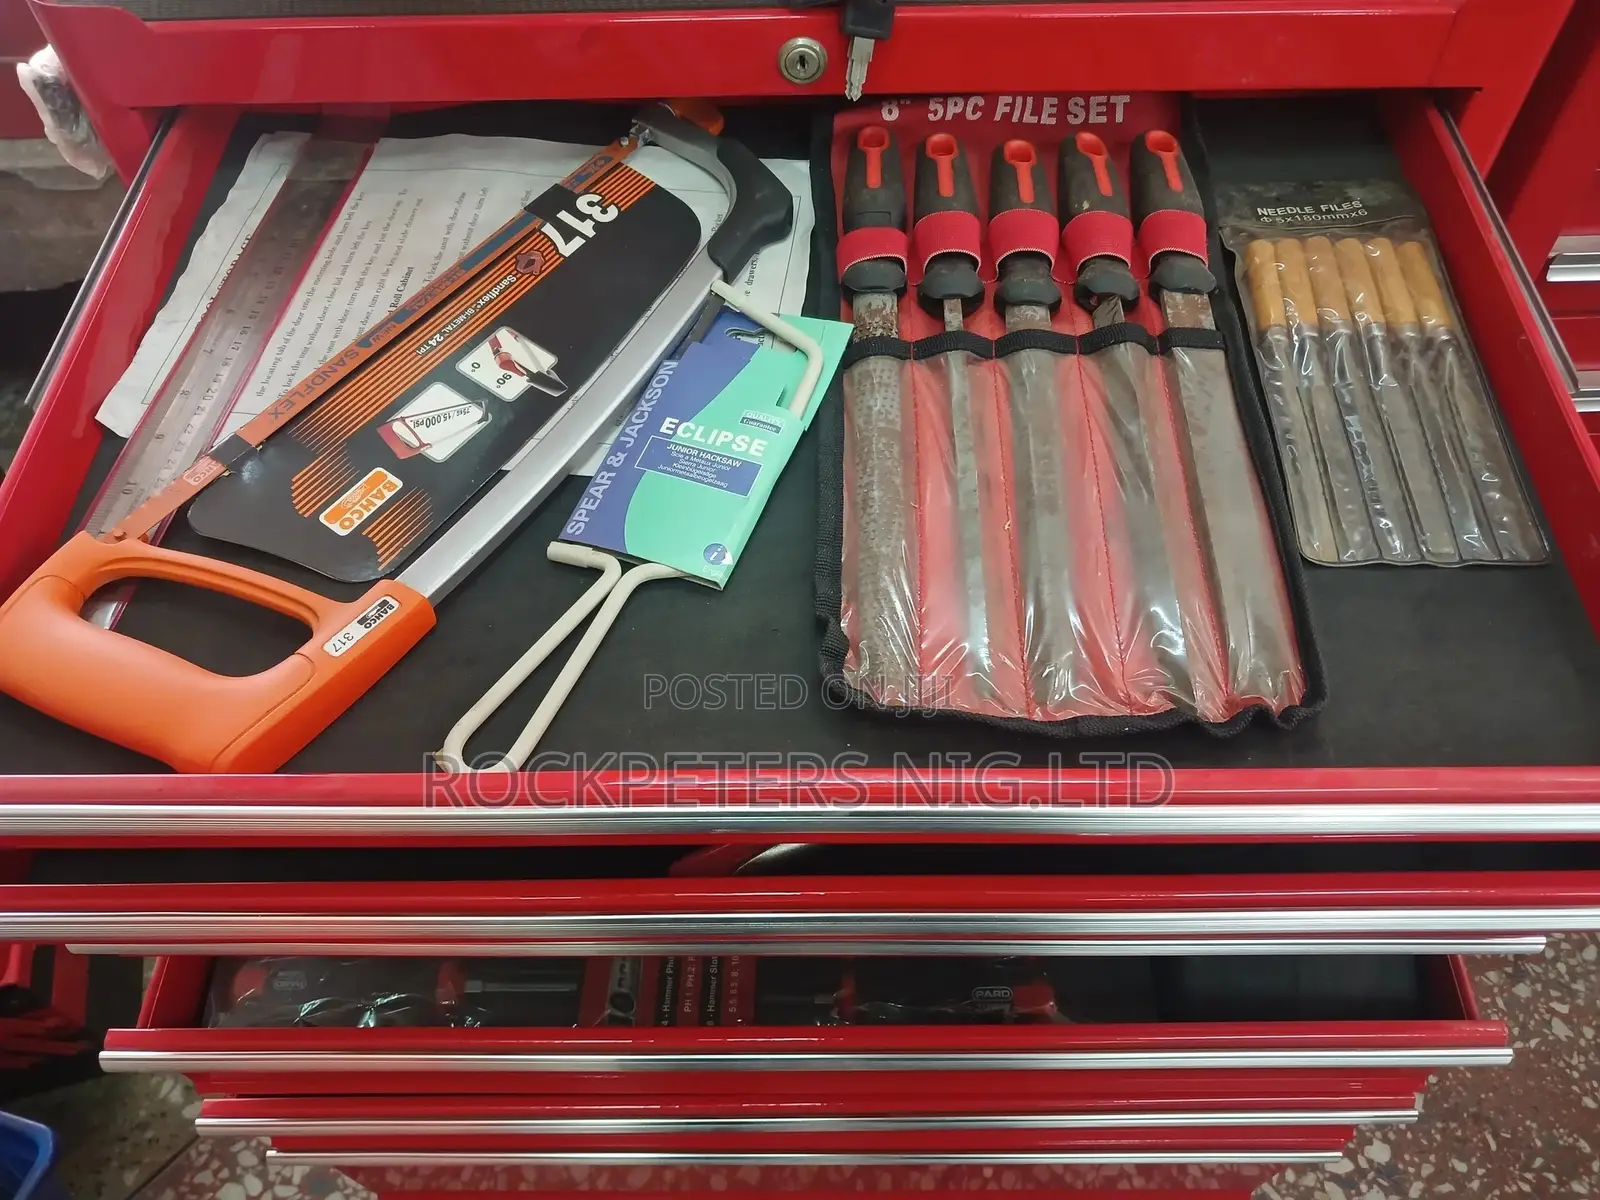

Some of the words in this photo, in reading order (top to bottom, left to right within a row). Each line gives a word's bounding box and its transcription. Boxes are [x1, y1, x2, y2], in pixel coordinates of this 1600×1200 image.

[927, 96, 983, 121] 5PC
[993, 95, 1058, 124] FILE
[1066, 94, 1131, 123] SET
[1257, 206, 1315, 216] NEEDLE
[1320, 200, 1363, 212] FILES
[541, 192, 619, 258] 317
[389, 292, 402, 308] Roll
[396, 264, 415, 293] Cabinet
[238, 323, 251, 337] 16
[439, 306, 475, 336] BI-METAL
[370, 321, 397, 343] NEW
[426, 331, 444, 348] 24
[228, 338, 242, 353] 17
[414, 342, 429, 356] TPI
[201, 385, 217, 403] 20
[267, 351, 357, 421] SANDFLEX
[192, 404, 206, 419] 21
[659, 417, 768, 457] ECLIPSE
[566, 471, 617, 536] SPEAR
[606, 451, 628, 468] &
[619, 360, 679, 448] JACKSON
[666, 443, 698, 458] JUNIOR
[699, 452, 742, 468] HACKSAW
[678, 458, 699, 468] Sierra
[700, 464, 717, 473] Junior
[712, 462, 731, 472] Junior
[120, 478, 137, 497] 10
[339, 480, 398, 530] BAHCO
[364, 603, 395, 629] BAHCO
[333, 632, 354, 652] 317
